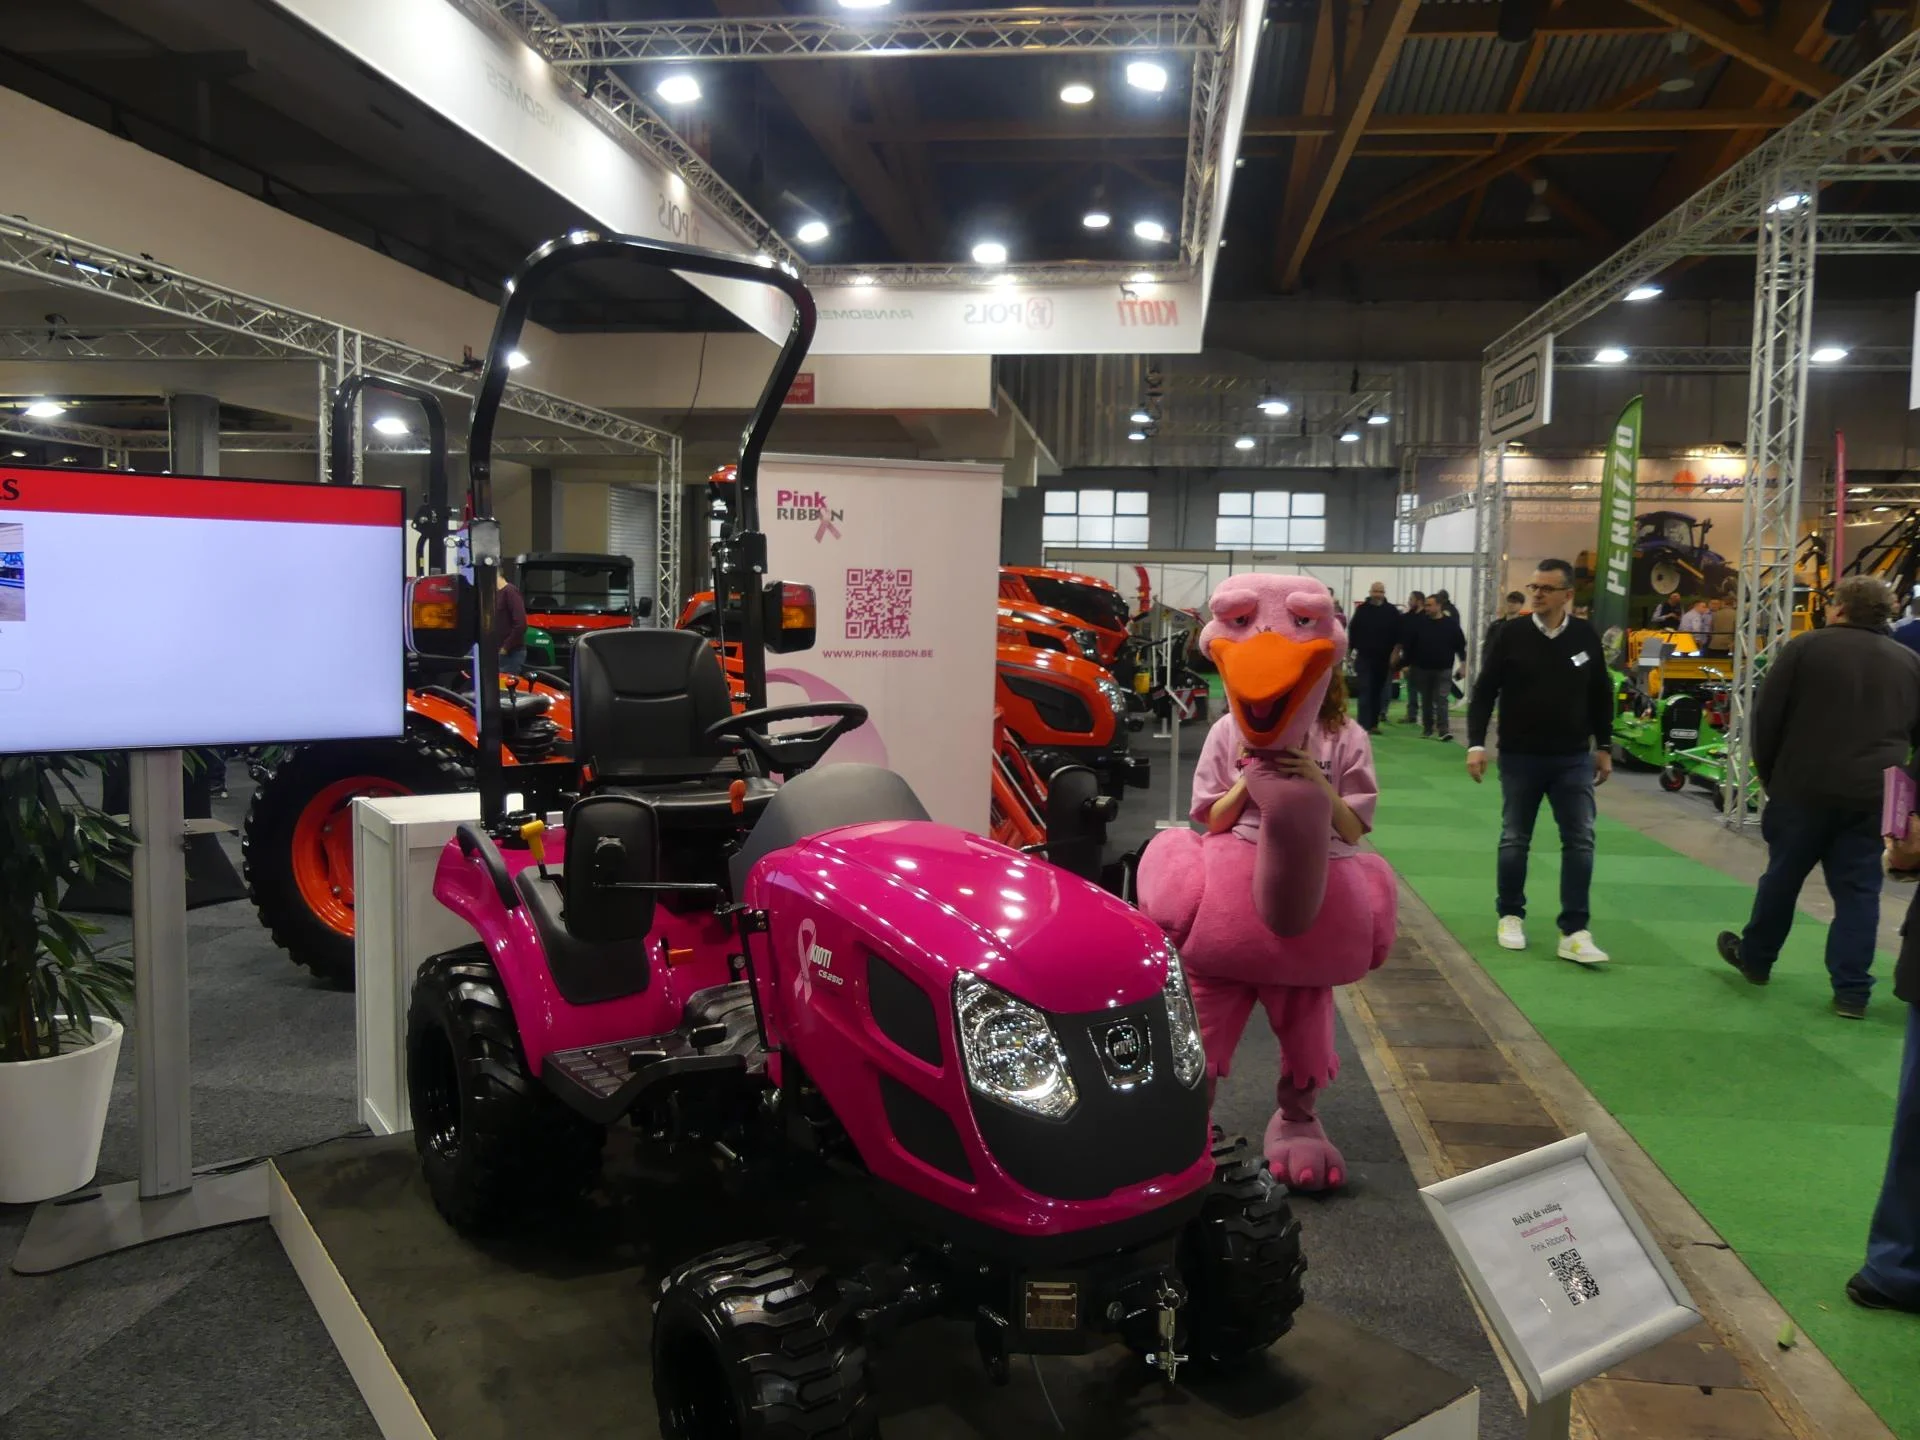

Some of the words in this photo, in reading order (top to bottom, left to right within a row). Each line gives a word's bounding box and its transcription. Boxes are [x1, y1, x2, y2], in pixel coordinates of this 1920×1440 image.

[777, 490, 827, 508] Pink
[1606, 425, 1634, 596] PERUZZO
[822, 649, 934, 659] WWW.PINK-RIBBON.BE
[810, 943, 833, 969] KIOTI
[1512, 1212, 1535, 1226] Bekijk
